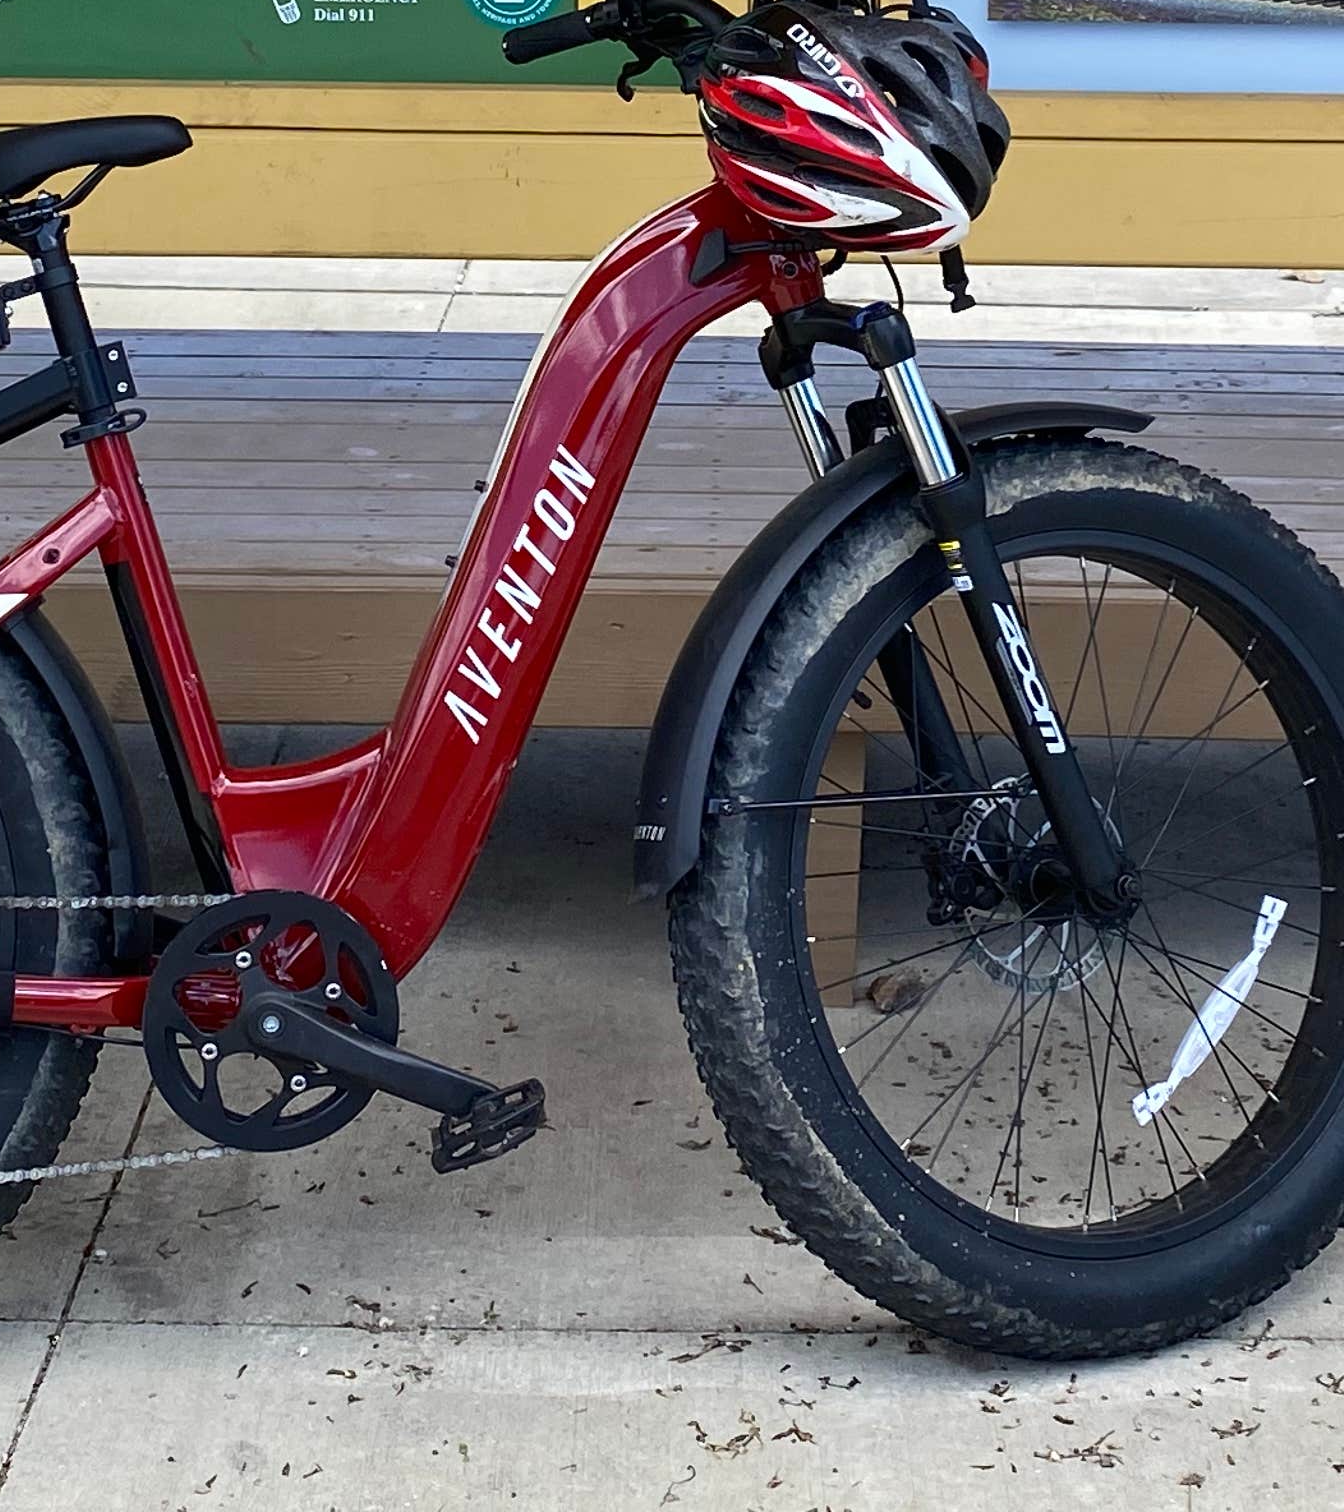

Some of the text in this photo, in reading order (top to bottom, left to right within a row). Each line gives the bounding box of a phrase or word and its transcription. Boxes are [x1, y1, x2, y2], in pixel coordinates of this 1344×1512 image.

[315, 8, 373, 21] Dial 911
[519, 12, 537, 24] AND
[786, 23, 842, 76] GIRO
[443, 442, 597, 745] AVENTON
